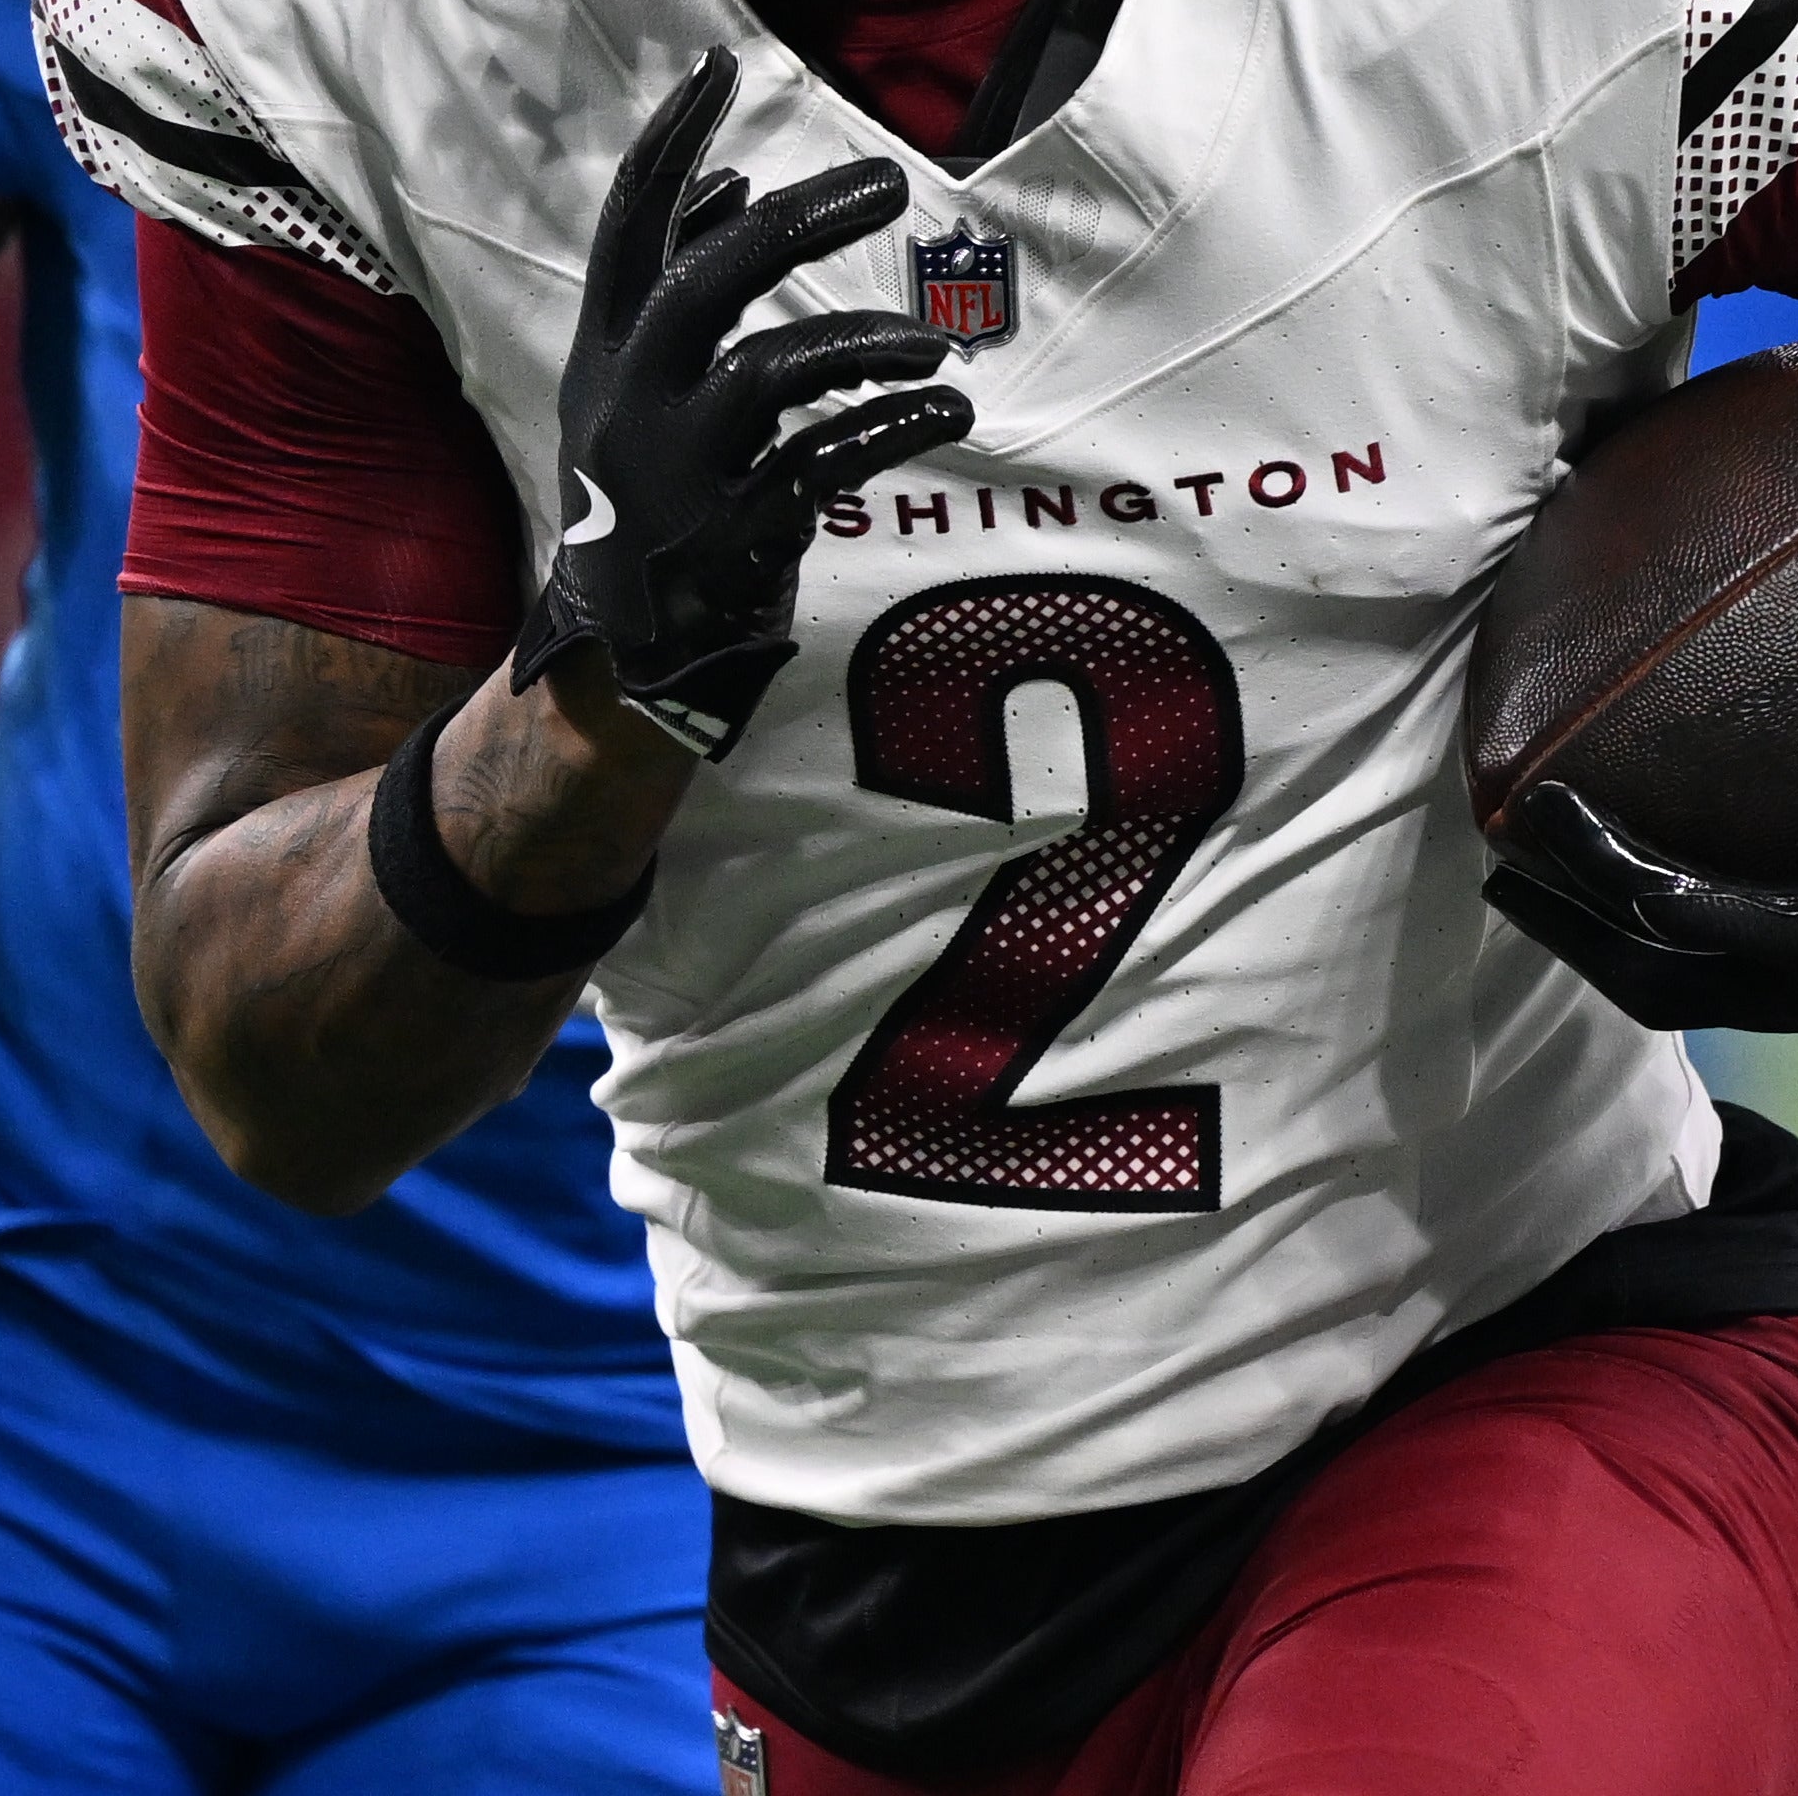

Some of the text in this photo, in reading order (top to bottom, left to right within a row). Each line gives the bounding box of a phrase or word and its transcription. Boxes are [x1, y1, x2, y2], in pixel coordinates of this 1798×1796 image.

[927, 283, 1003, 334] NFL
[822, 442, 1387, 538] SHINGTON
[824, 572, 1246, 1214] 2
